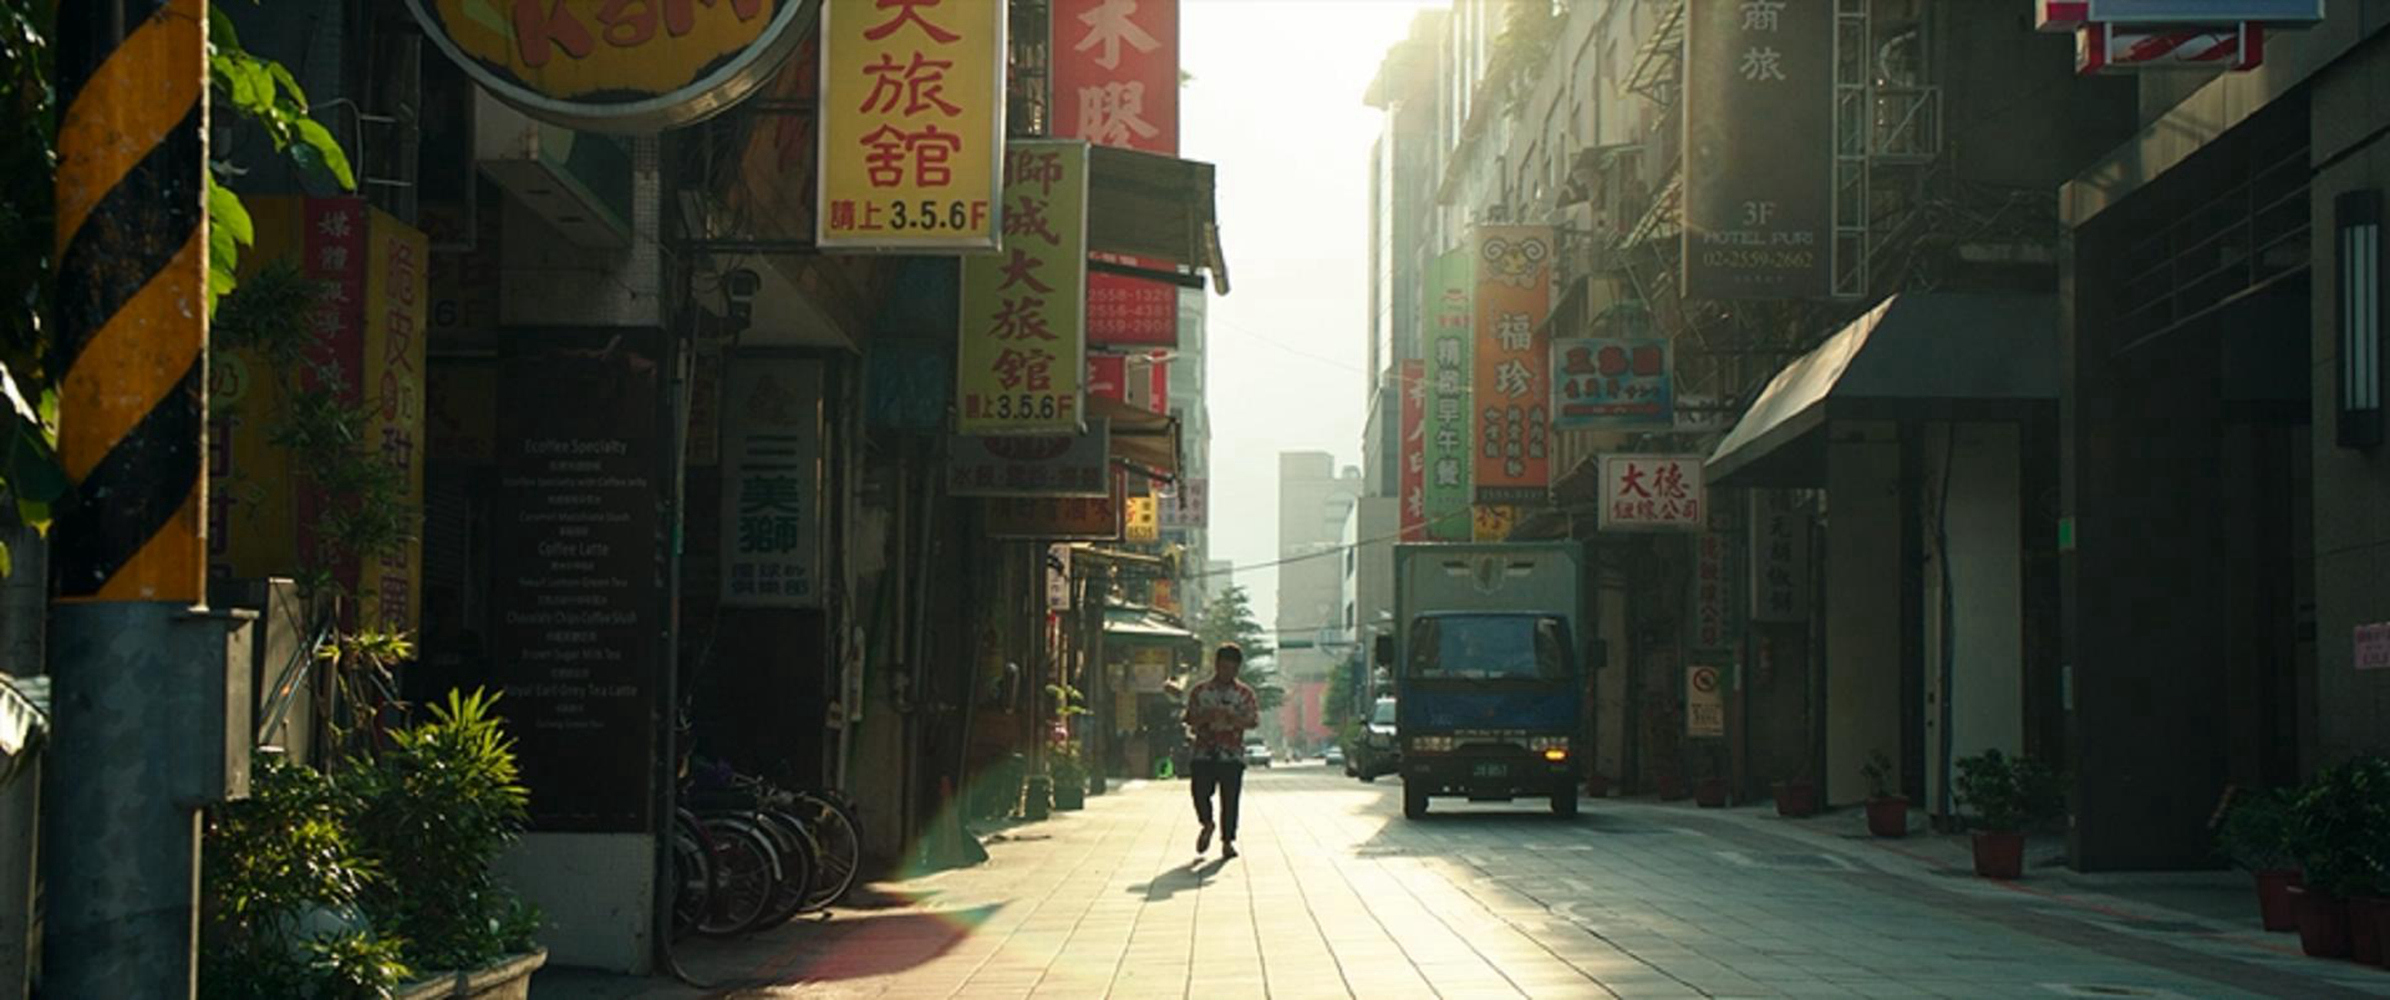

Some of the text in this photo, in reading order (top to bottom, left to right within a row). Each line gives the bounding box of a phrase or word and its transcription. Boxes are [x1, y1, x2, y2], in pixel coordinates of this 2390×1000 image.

[1740, 0, 1787, 81] 商旅
[859, 0, 963, 188] 大旅館
[1742, 201, 1777, 226] 3F
[1703, 231, 1813, 245] HOTEL PURI
[987, 148, 1064, 392] 獅城大旅館
[1703, 251, 1813, 268] 02-2559-2662
[1494, 313, 1538, 399] 福珍
[1618, 461, 1691, 499] 大德
[537, 540, 610, 558] Coffee Latte
